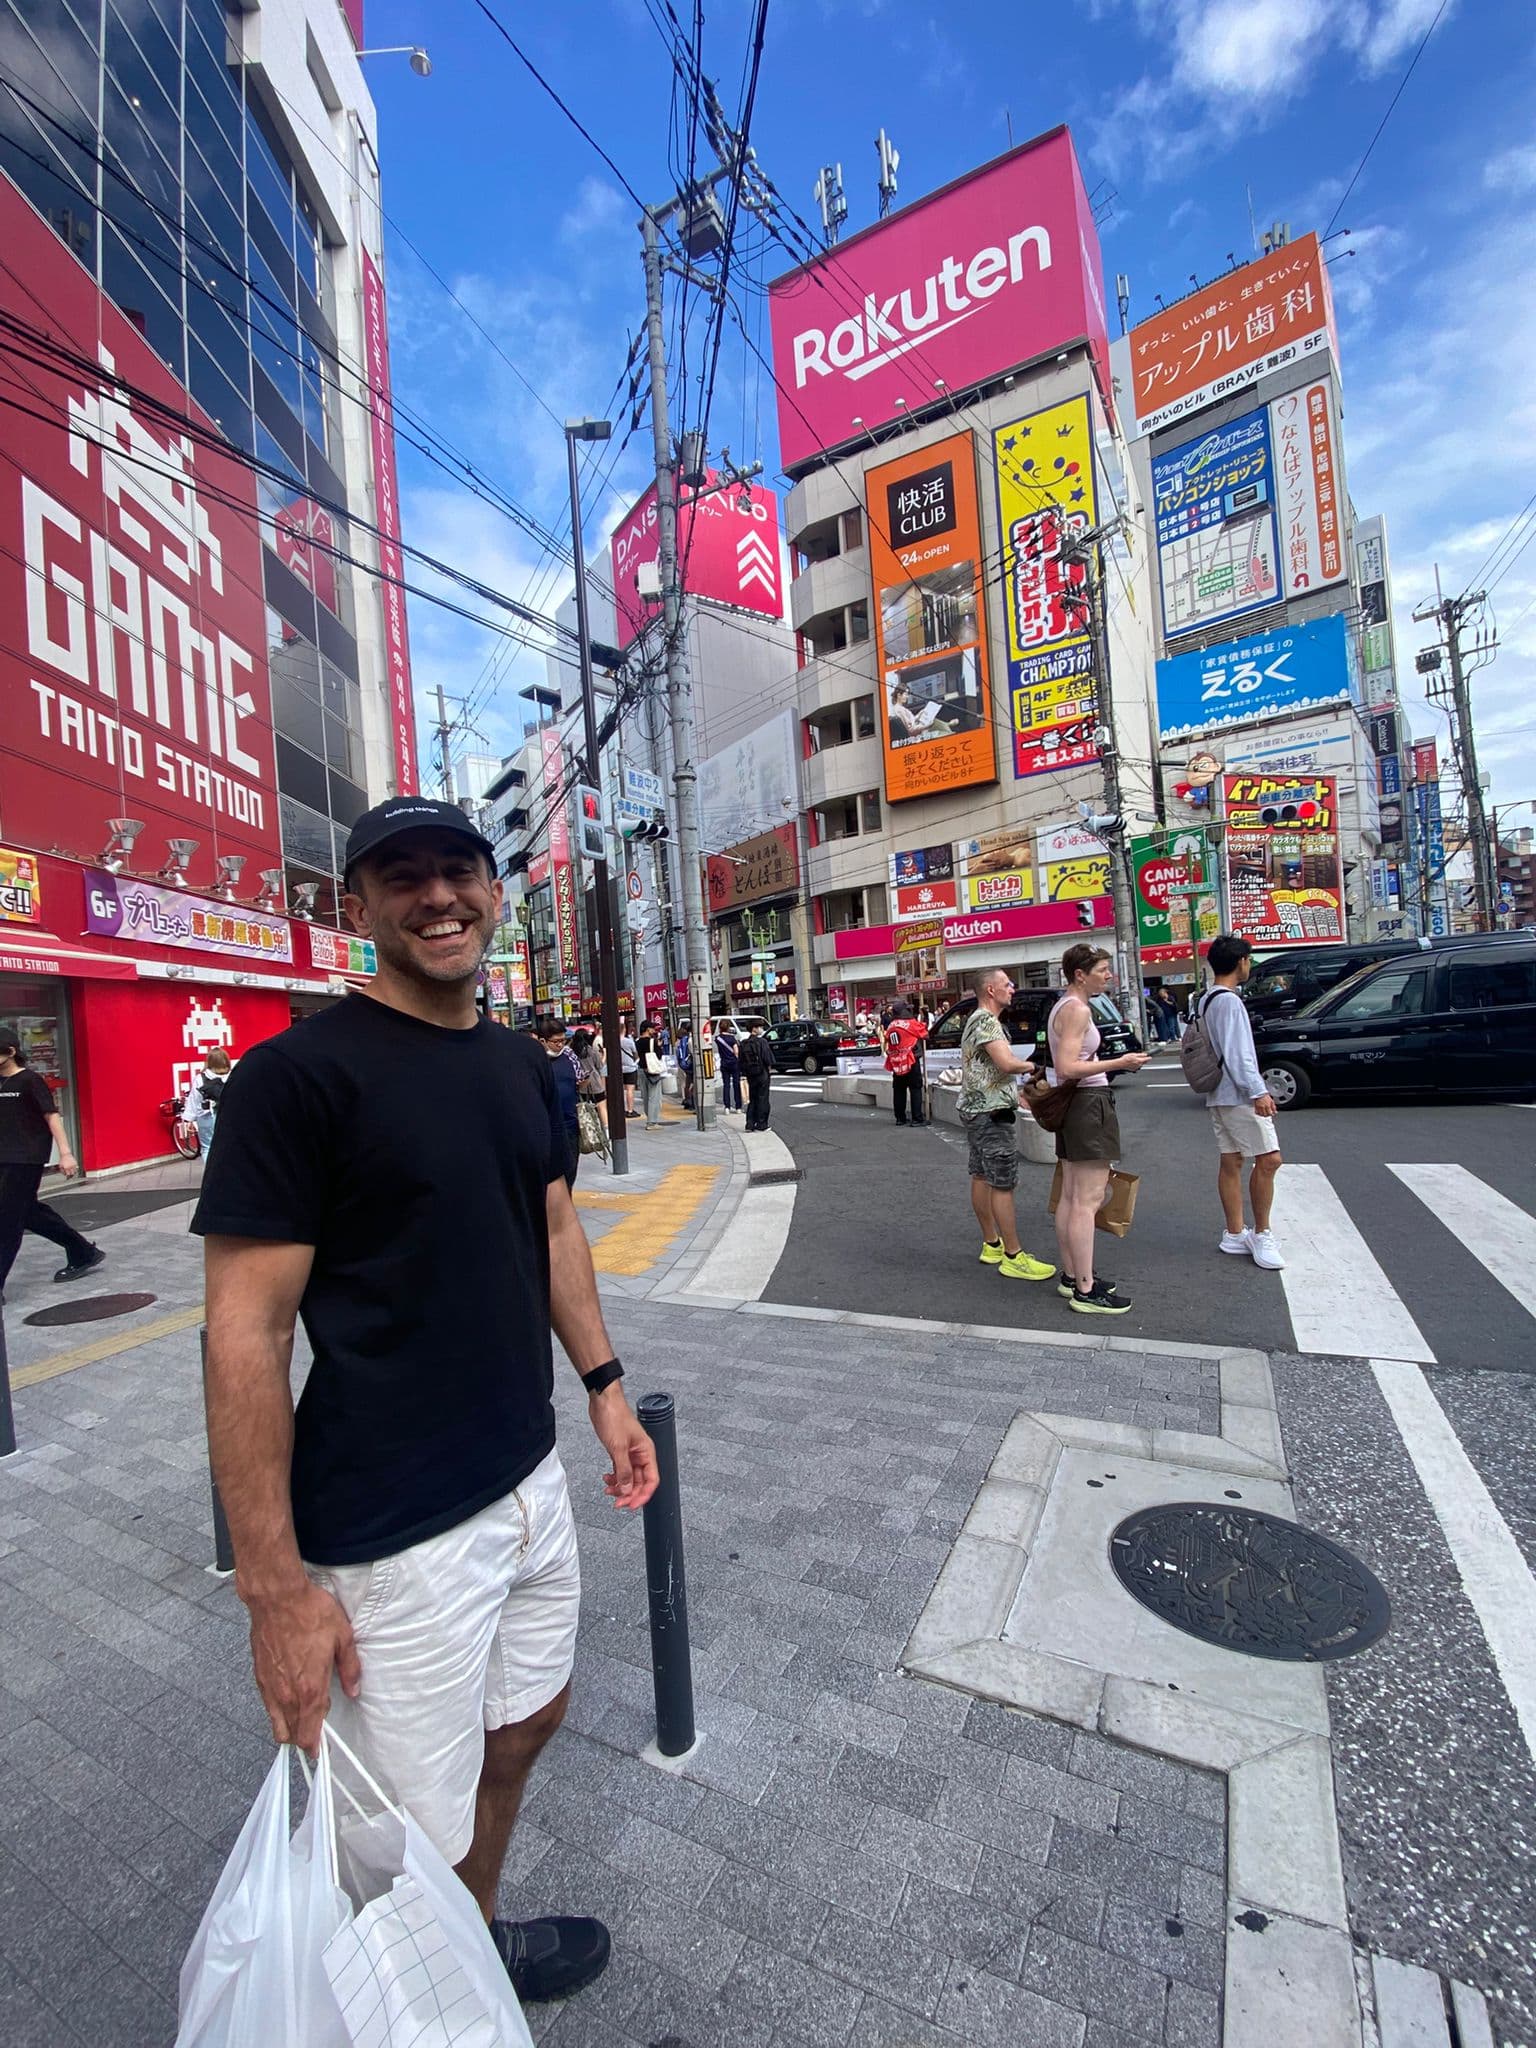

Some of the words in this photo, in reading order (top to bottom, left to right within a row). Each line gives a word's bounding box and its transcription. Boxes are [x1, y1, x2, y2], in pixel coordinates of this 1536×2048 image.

[793, 226, 1052, 389] Rakuten
[1138, 281, 1316, 397] アップル歯科
[1304, 334, 1322, 351] 5F
[377, 398, 394, 540] WELCOME
[898, 477, 945, 515] 快活
[1158, 455, 1267, 515] パソコンショップ
[1281, 424, 1308, 573] なんばアップル歯科
[617, 501, 657, 565] DAIS
[900, 505, 946, 534] CLUB
[923, 543, 950, 559] OPEN
[21, 475, 260, 778] GAME
[1020, 654, 1051, 669] TRADING
[1054, 649, 1073, 660] CARD
[1201, 651, 1297, 702] えるく
[1034, 688, 1052, 703] 4F
[1035, 708, 1052, 722] 3F
[30, 679, 144, 778] TAITO
[155, 741, 264, 830] STATION
[903, 739, 973, 767] 振り返って
[904, 754, 974, 779] みてください
[1144, 863, 1189, 883] CAND
[90, 890, 117, 918] 6F
[907, 901, 946, 912] HARERUYA
[944, 919, 1002, 939] akuten
[25, 958, 59, 972] STATION
[647, 989, 667, 1003] DAIS
